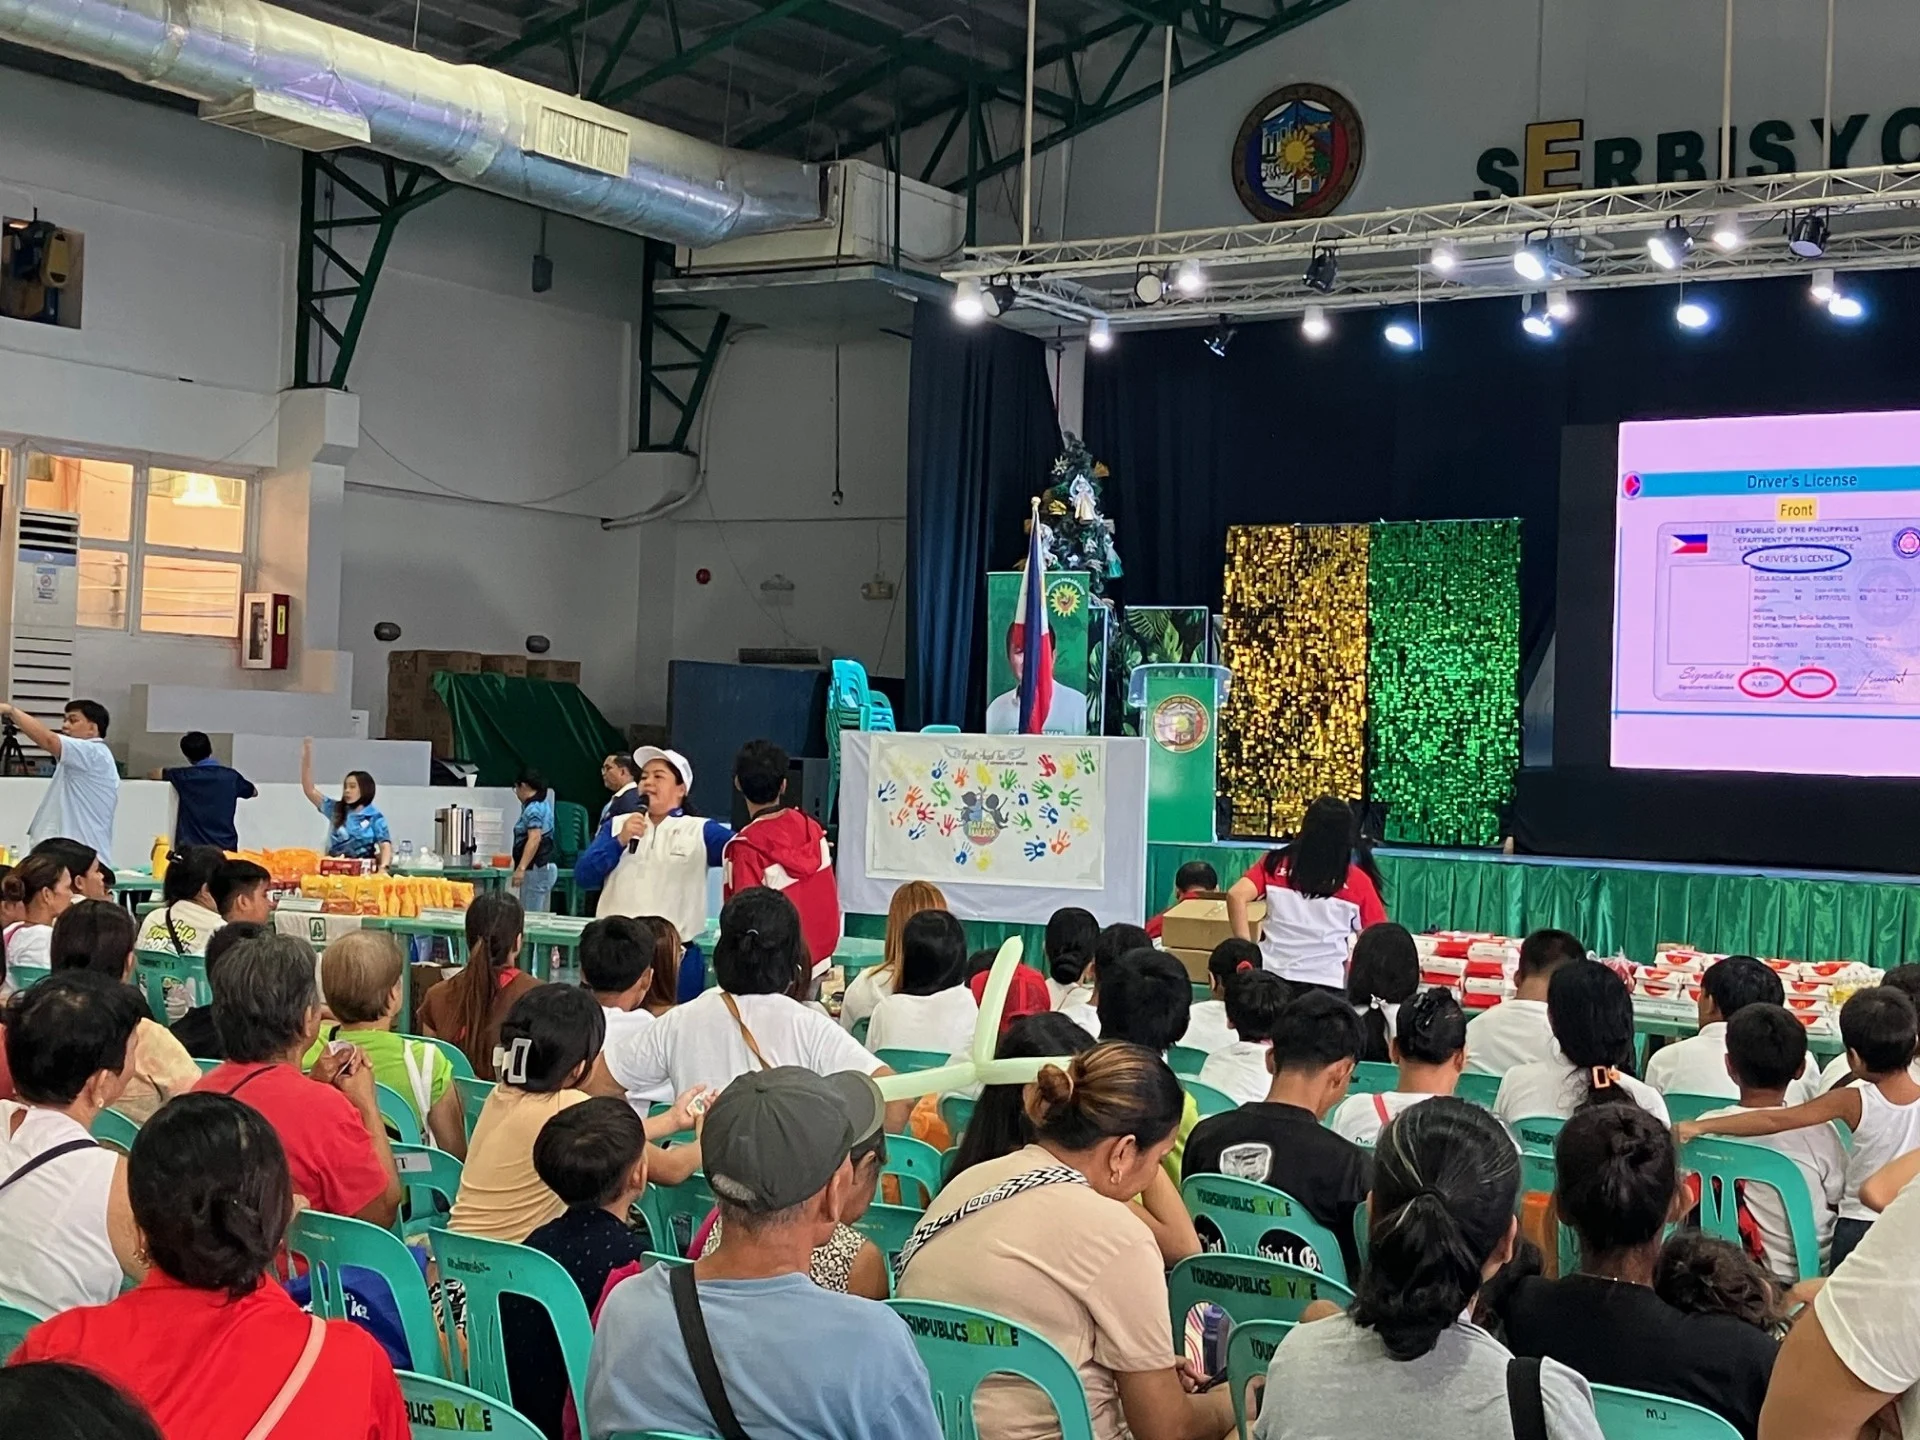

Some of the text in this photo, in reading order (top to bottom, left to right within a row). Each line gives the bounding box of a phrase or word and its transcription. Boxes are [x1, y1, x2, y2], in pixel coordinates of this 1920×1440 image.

[1747, 472, 1858, 489] Driver's License
[1780, 503, 1813, 516] Front
[1758, 554, 1834, 563] DRIVER'S LICENSE
